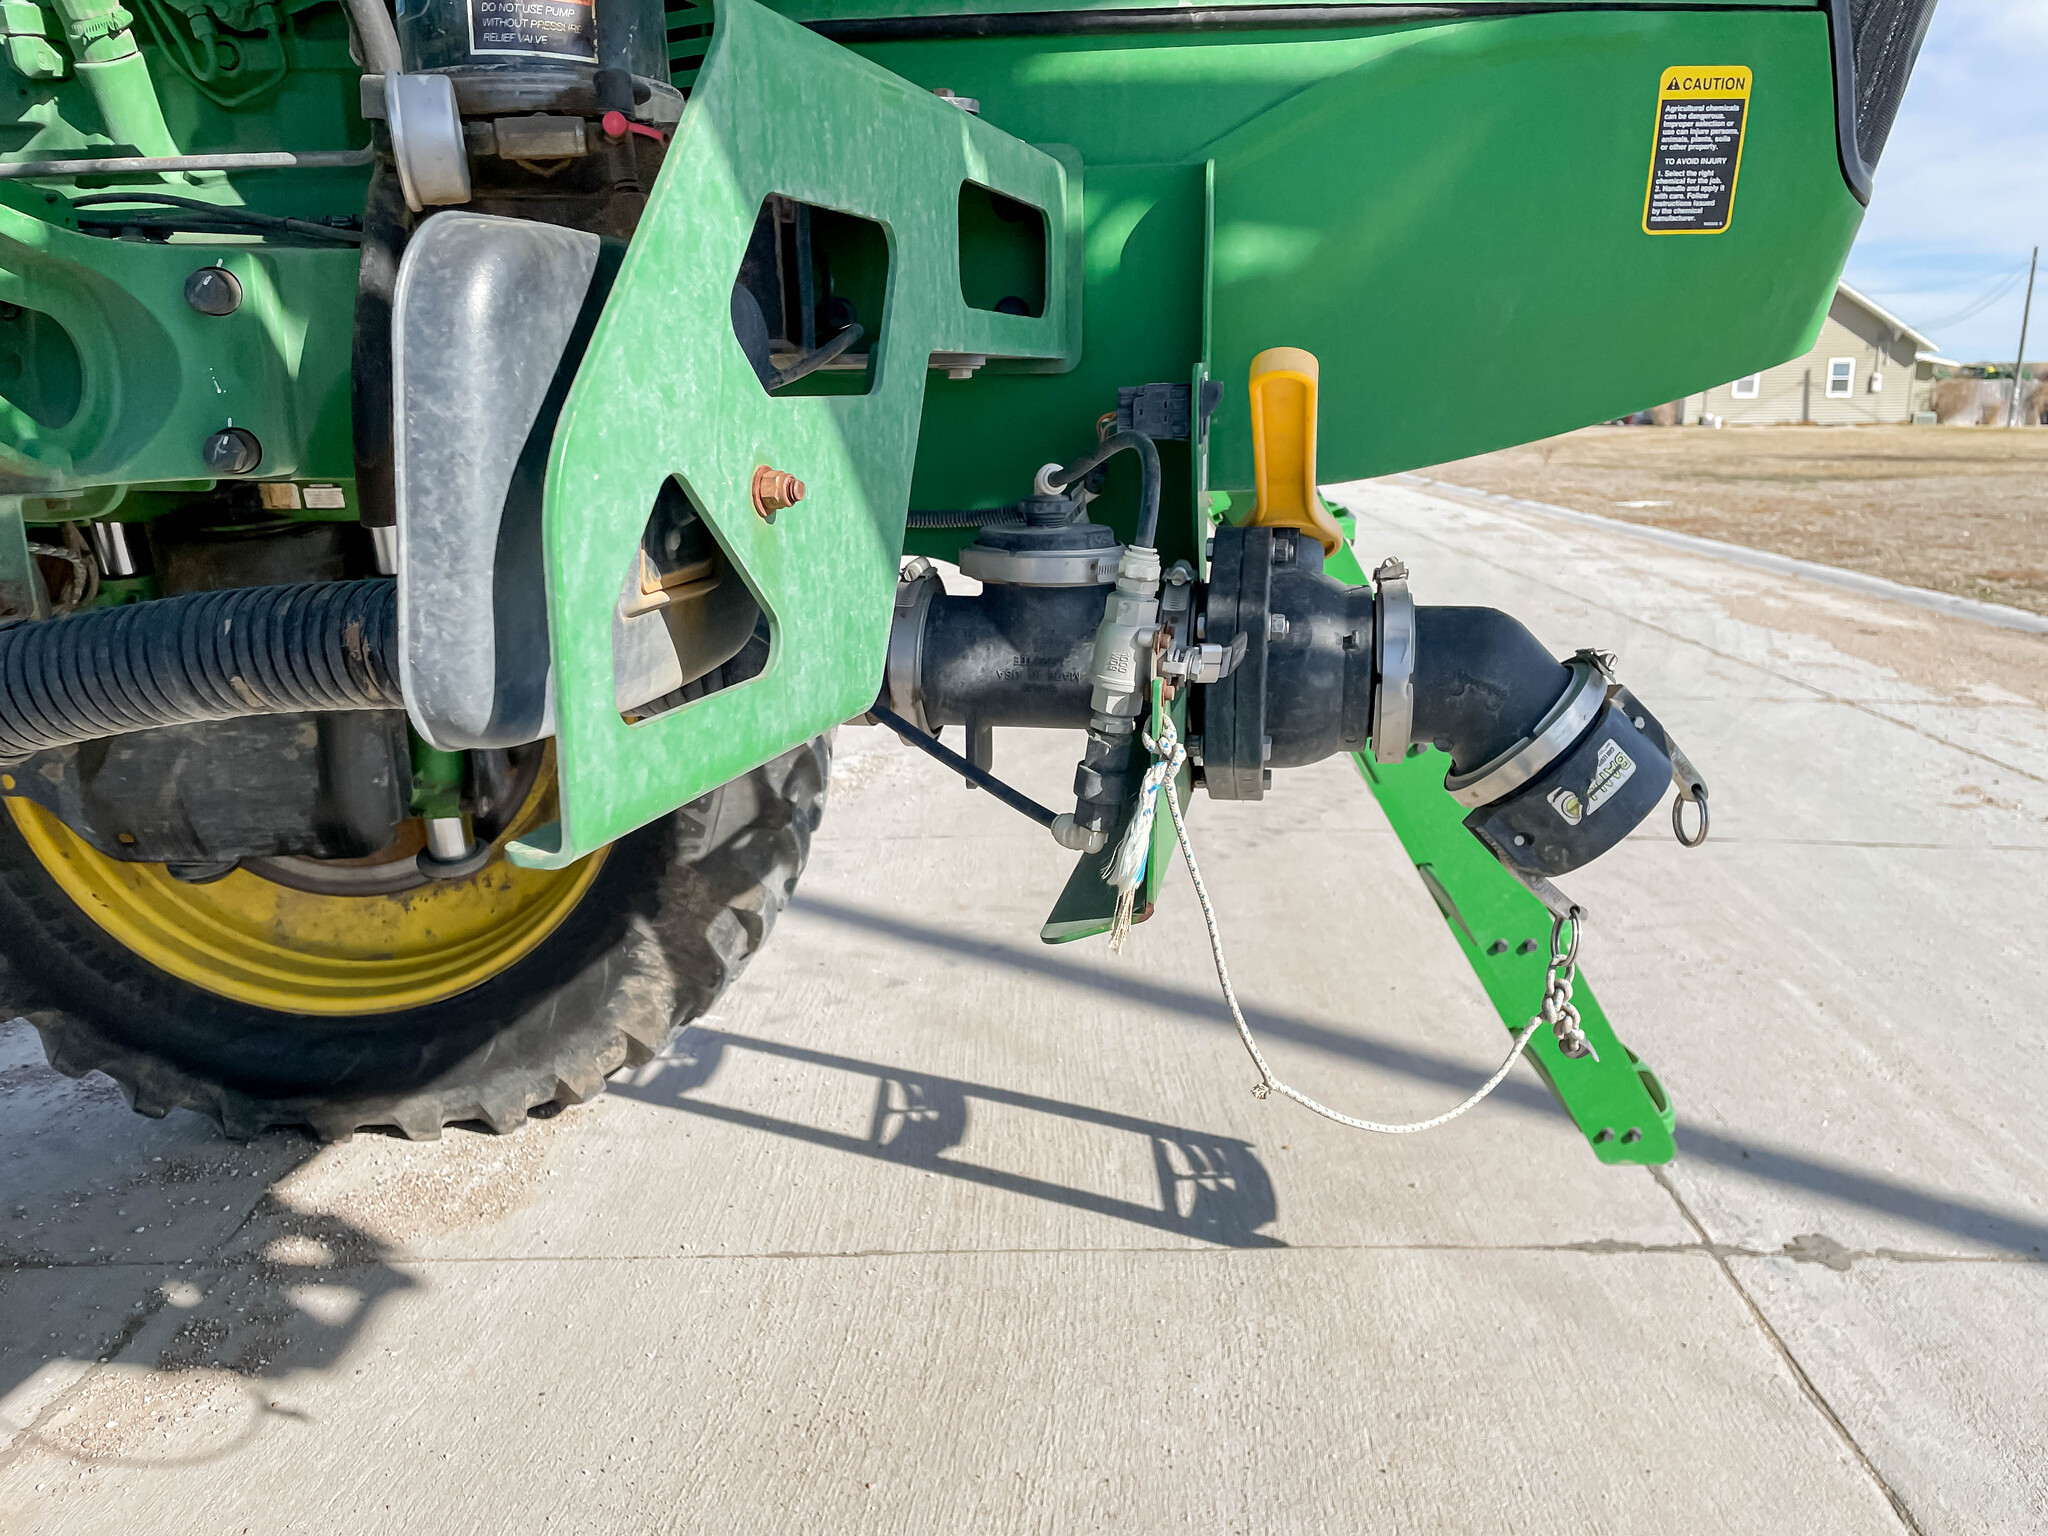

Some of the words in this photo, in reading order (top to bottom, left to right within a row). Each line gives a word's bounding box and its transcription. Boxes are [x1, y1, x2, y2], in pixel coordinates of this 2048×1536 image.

[481, 3, 495, 12] DO
[499, 4, 518, 13] NOT
[523, 4, 543, 15] USE
[545, 7, 575, 18] PUMP
[482, 18, 528, 28] WITHOUT
[484, 33, 516, 42] RELIEF
[1683, 77, 1746, 90] CAUTION
[1665, 105, 1705, 113] Agricultural
[1688, 113, 1726, 121] dangerous.
[1690, 128, 1709, 137] injure
[1699, 170, 1715, 178] right
[1709, 177, 1722, 185] job.
[1701, 185, 1719, 193] apply
[1652, 208, 1660, 216] by
